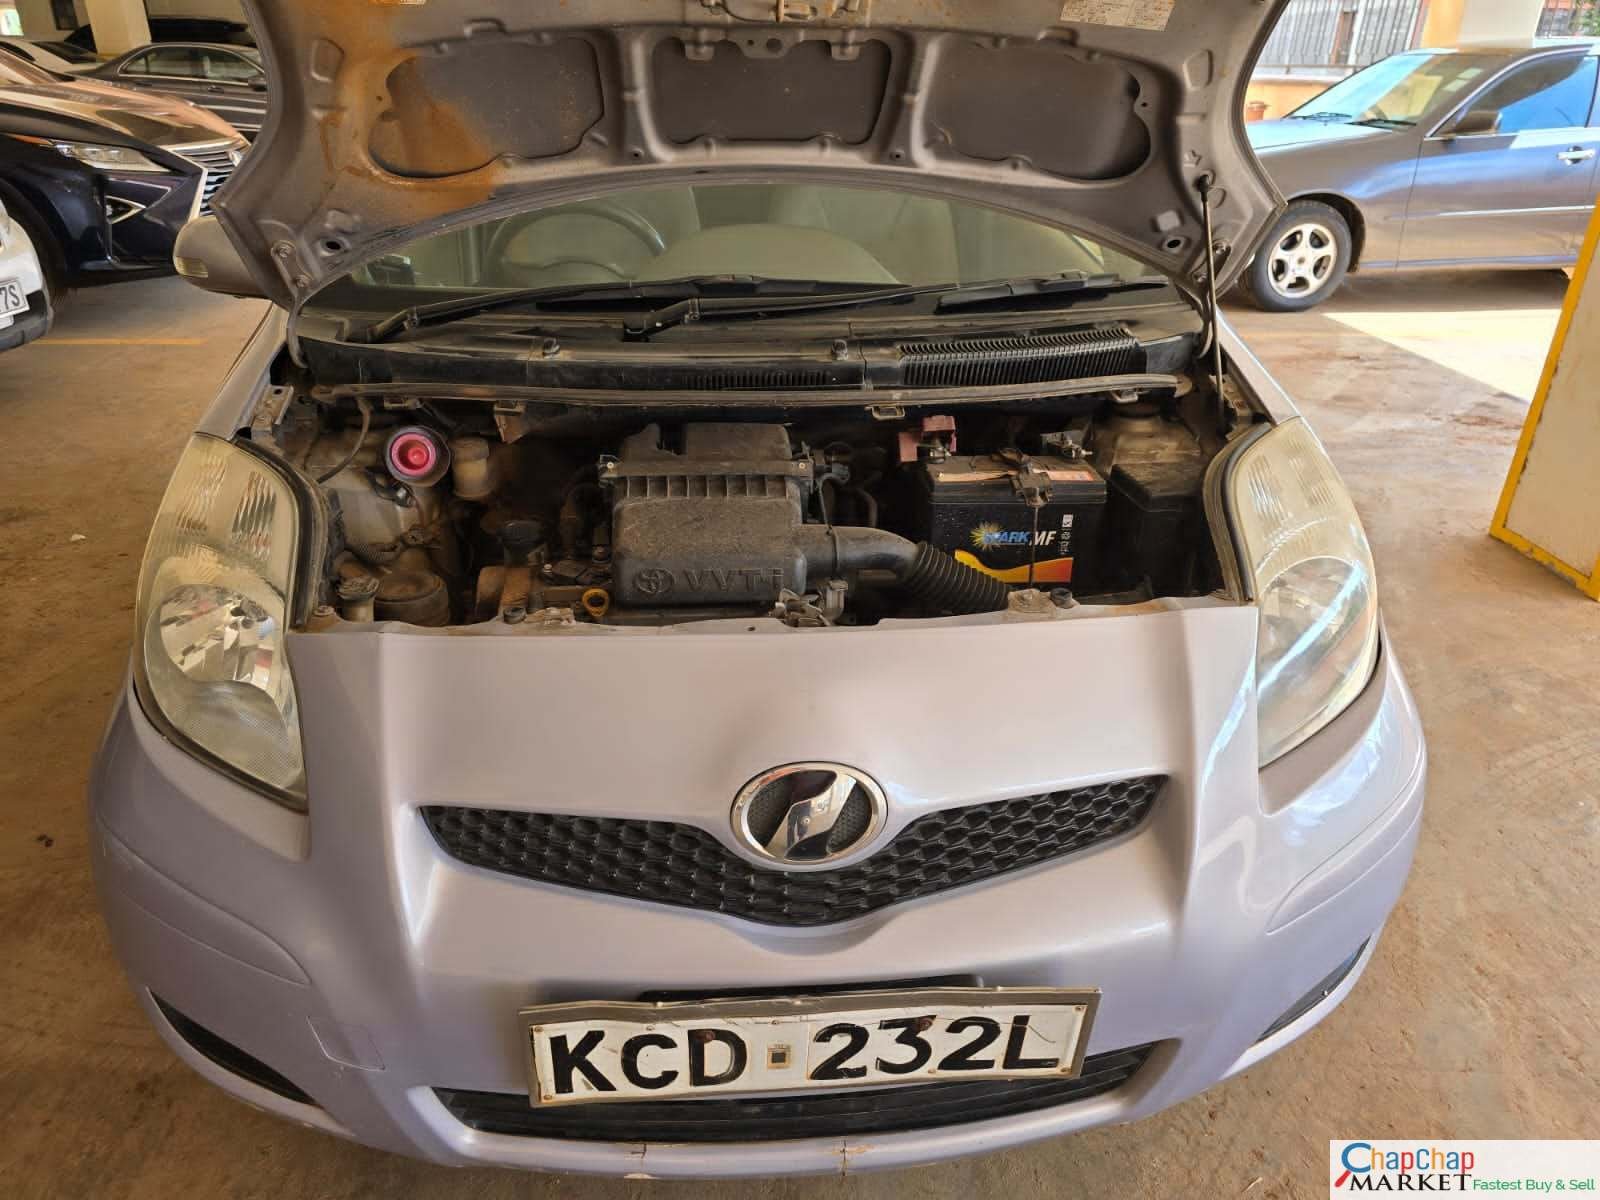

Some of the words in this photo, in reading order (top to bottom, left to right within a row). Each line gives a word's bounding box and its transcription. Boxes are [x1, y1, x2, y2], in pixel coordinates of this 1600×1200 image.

[0, 285, 20, 310] 7S
[549, 1028, 748, 1094] KCD
[806, 1014, 1060, 1081] 232L
